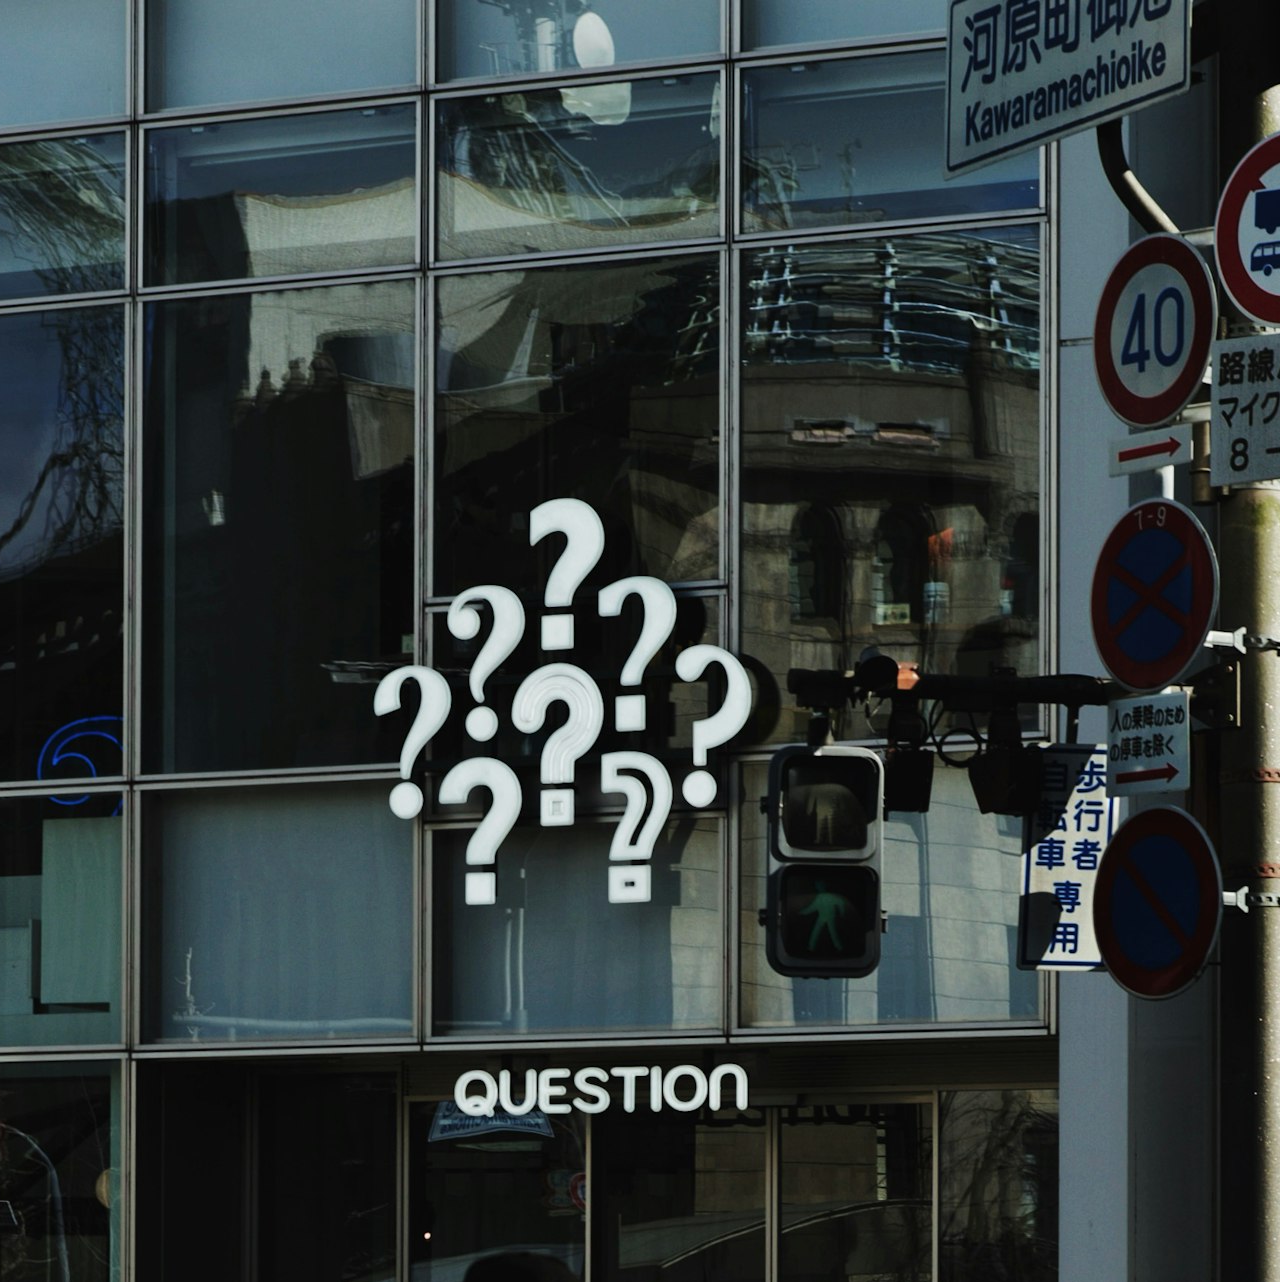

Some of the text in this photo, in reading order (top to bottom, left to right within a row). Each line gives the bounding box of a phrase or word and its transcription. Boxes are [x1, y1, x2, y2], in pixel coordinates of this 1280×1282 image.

[965, 39, 1167, 147] Kawaramachioike
[1121, 286, 1185, 373] 40
[1133, 505, 1167, 531] 7-9
[1110, 704, 1186, 733] 人の乗降のため
[1110, 733, 1175, 762] の停車を除く
[1035, 759, 1069, 871] 自転車
[1071, 760, 1108, 871] 歩行者
[1050, 880, 1082, 954] 専用
[453, 1062, 749, 1119] QUESTION
